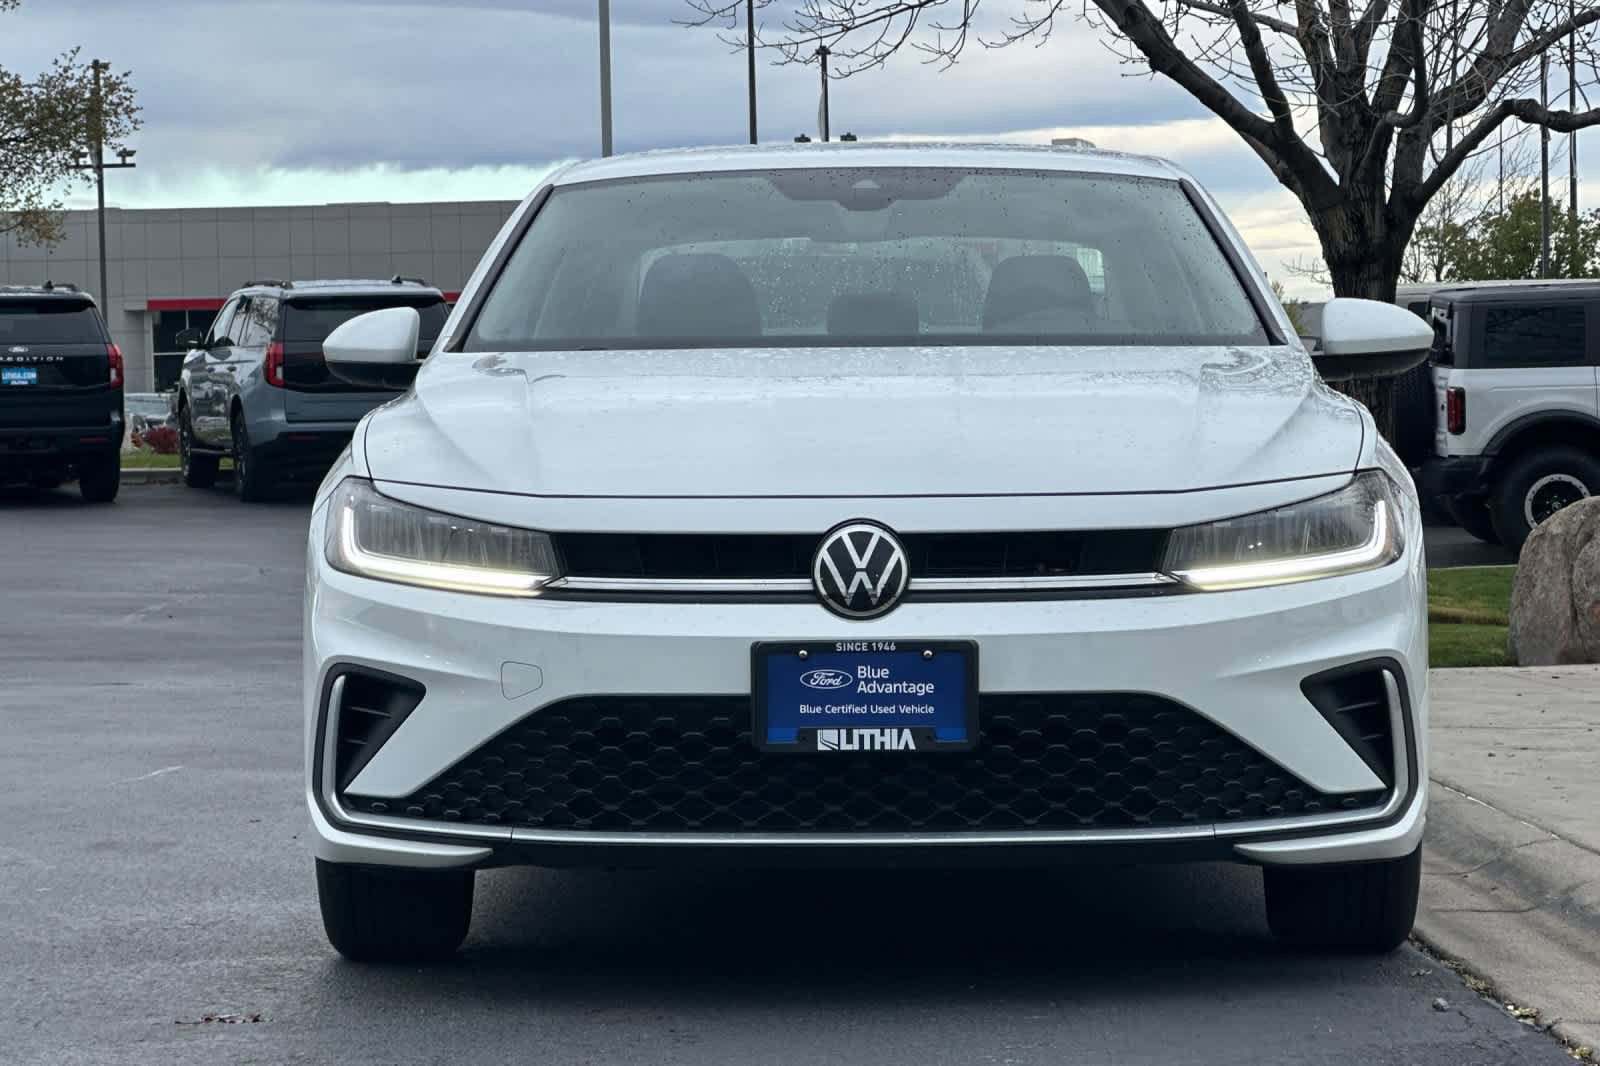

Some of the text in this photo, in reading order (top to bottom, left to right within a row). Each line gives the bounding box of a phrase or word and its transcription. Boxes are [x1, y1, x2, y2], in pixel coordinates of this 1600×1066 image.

[836, 642, 896, 651] SINCE 1946
[810, 671, 842, 686] Ford
[857, 665, 889, 679] Blue
[857, 681, 934, 696] Advantage
[799, 704, 935, 714] Blue Certified Used Vehicle
[840, 729, 916, 751] LITHIA
